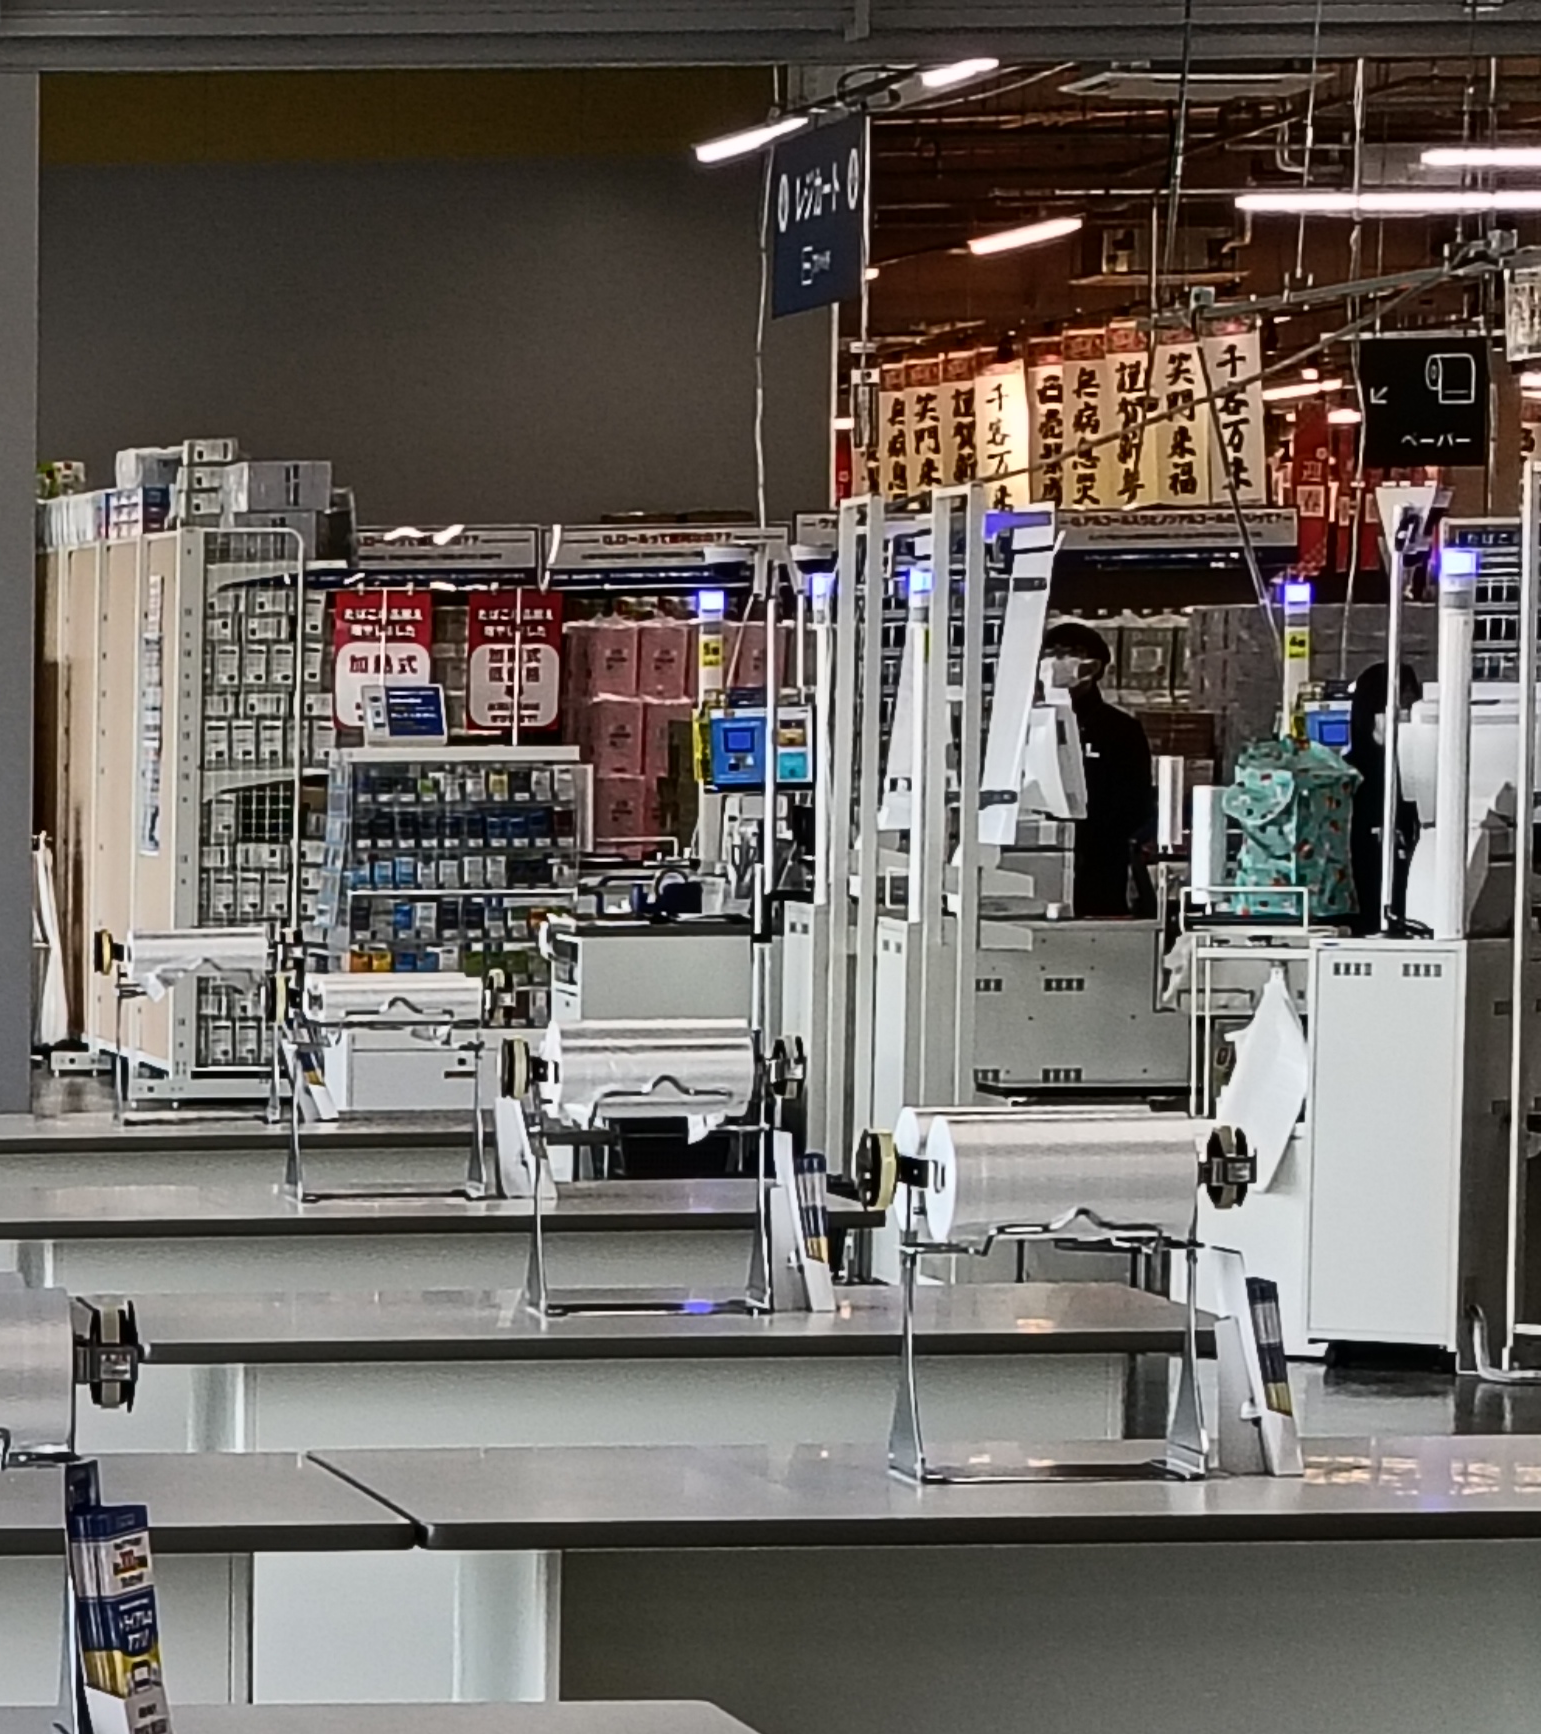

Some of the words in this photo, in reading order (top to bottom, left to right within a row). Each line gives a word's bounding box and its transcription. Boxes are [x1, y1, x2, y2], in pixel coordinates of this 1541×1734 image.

[795, 161, 841, 222] レジカート
[913, 393, 943, 488] 笑門来
[950, 388, 977, 484] 謹賀新
[1165, 352, 1199, 497] 笑門来福
[1217, 343, 1253, 491] 千客万来
[1400, 431, 1472, 448] ペーパー
